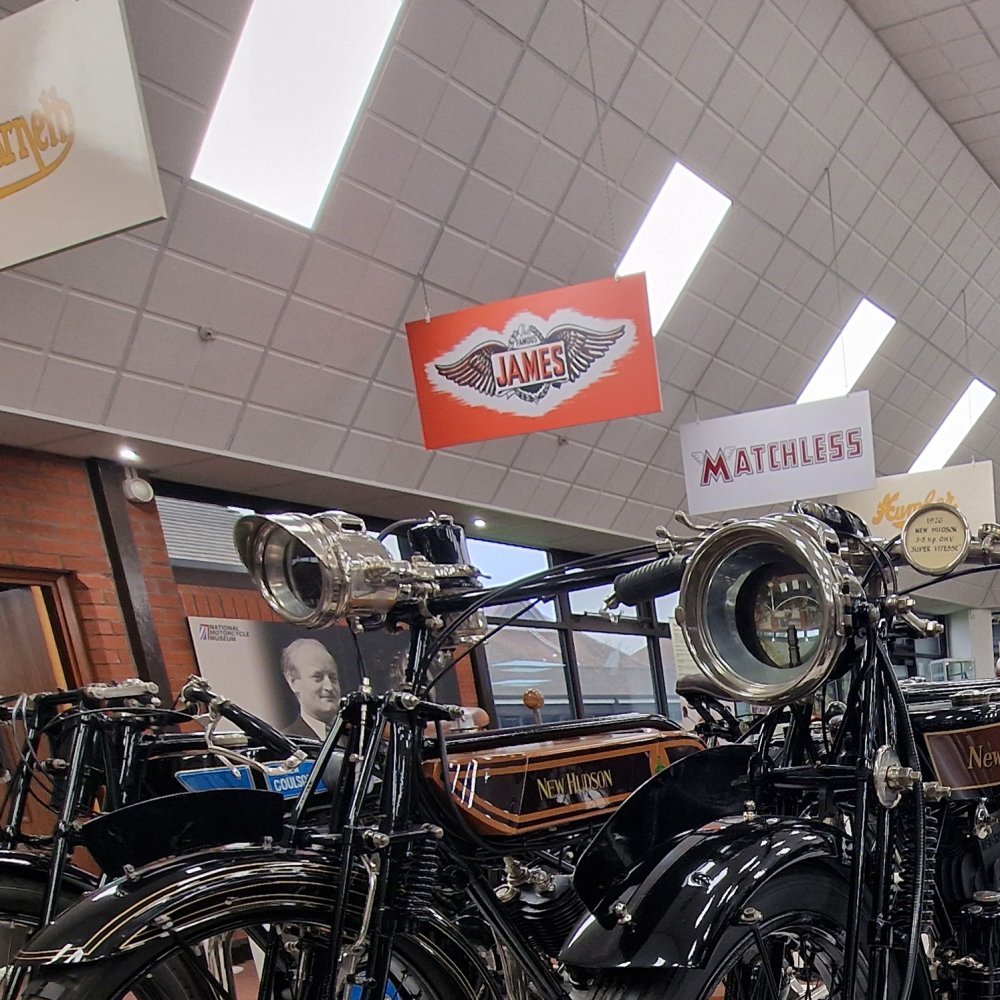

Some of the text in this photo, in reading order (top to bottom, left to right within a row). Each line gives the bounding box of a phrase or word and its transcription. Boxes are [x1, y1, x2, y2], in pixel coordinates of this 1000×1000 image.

[497, 345, 565, 387] JAMES
[700, 427, 863, 486] MATCHLESS
[931, 525, 957, 533] HUDSON
[273, 774, 310, 792] COULSO
[537, 769, 613, 800] NEW HUDSON
